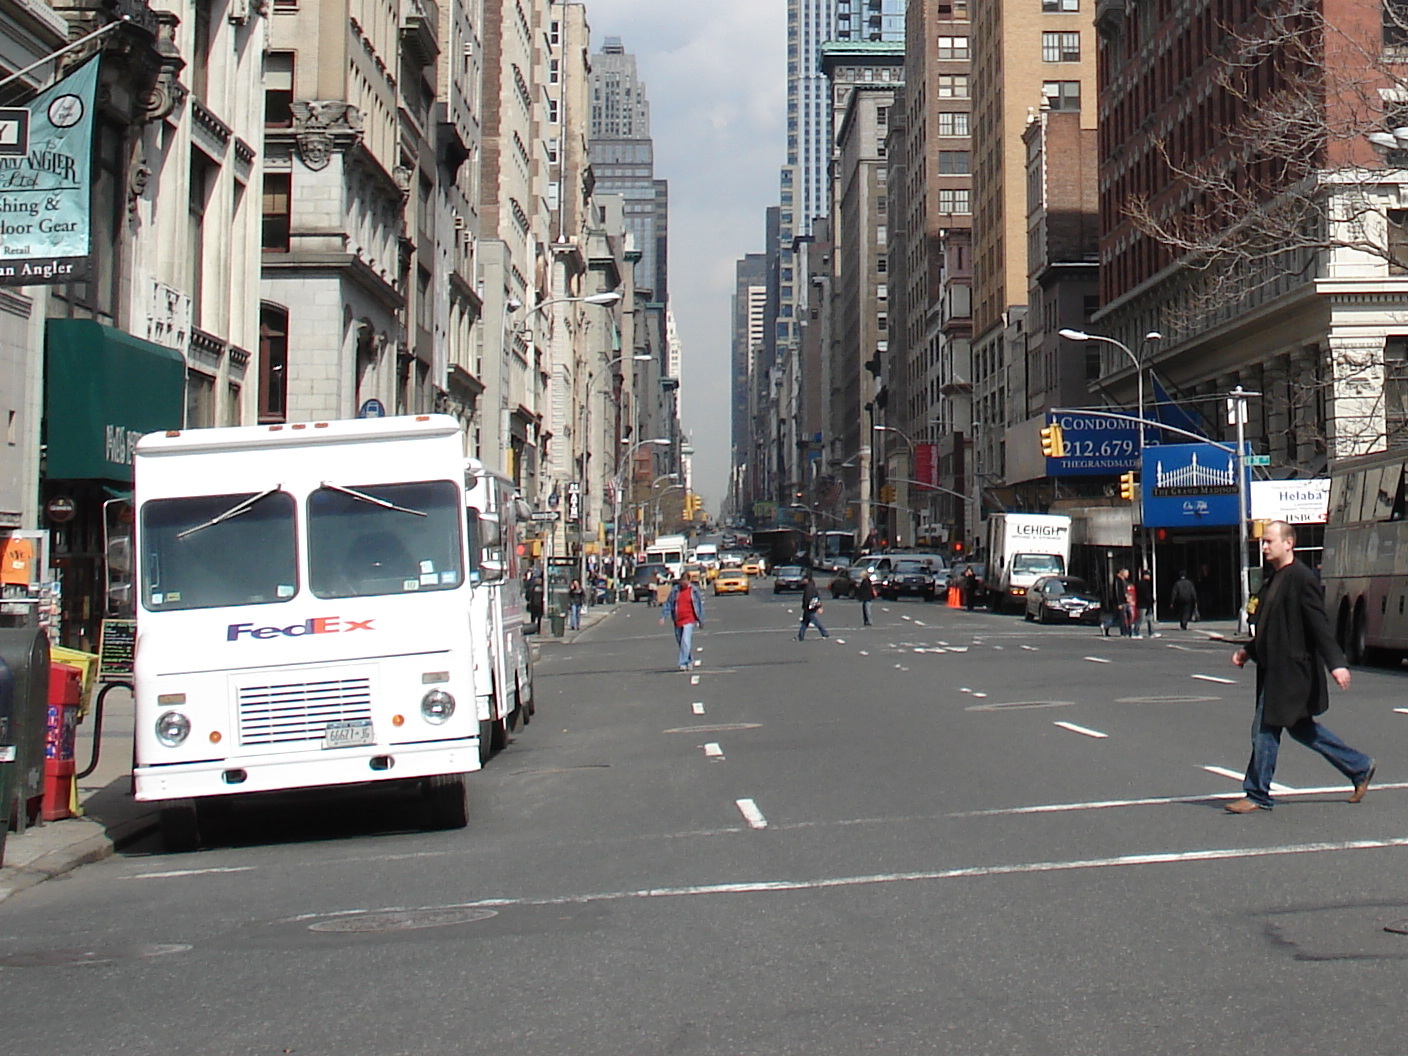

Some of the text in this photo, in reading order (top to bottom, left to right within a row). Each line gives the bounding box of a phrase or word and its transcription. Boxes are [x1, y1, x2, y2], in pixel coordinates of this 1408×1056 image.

[45, 197, 60, 211] &
[39, 219, 77, 233] Gear
[4, 246, 31, 255] Retail
[21, 261, 73, 278] Angler
[1280, 491, 1322, 501] Helaba
[1017, 525, 1059, 536] LEHIGH
[227, 616, 376, 642] FedEx
